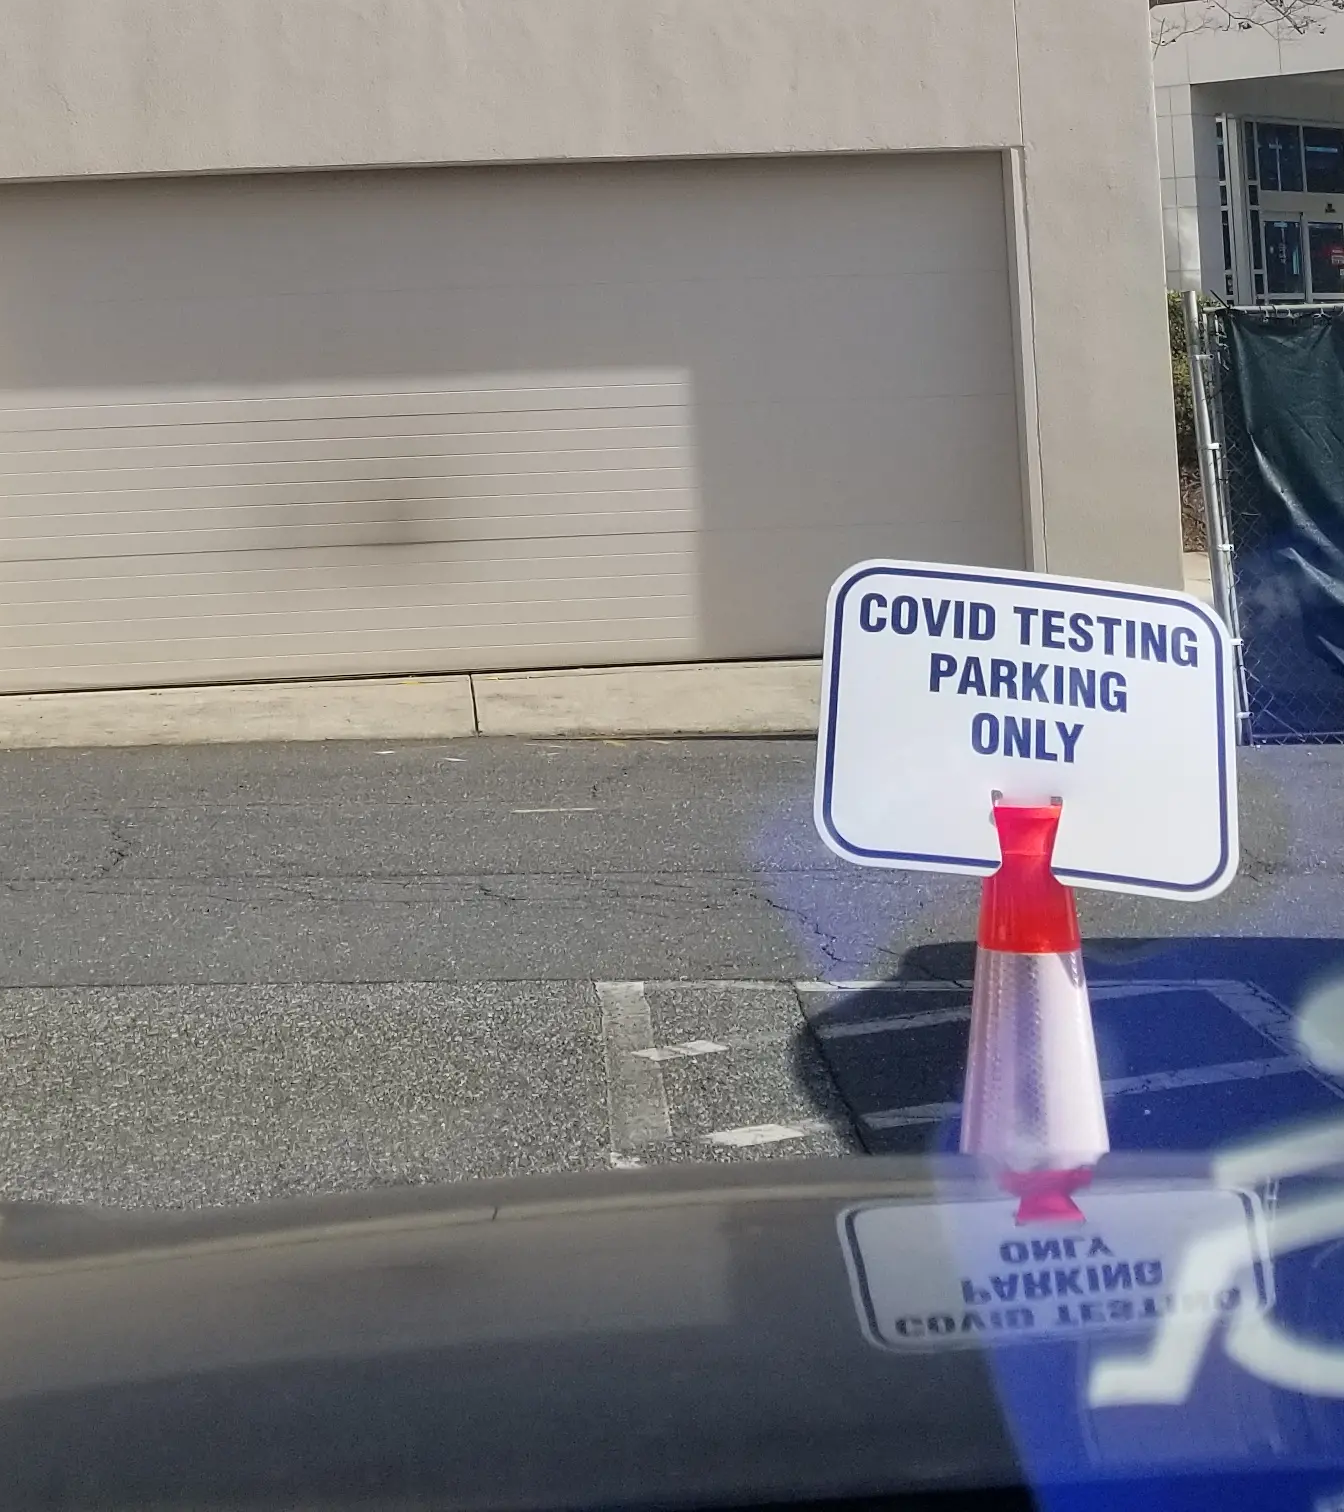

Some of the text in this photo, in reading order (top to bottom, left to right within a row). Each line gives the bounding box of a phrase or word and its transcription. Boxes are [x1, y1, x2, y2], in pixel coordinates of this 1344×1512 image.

[859, 592, 1199, 669] COVID TESTING
[929, 652, 1128, 714] PARKING
[971, 712, 1084, 764] ONLY
